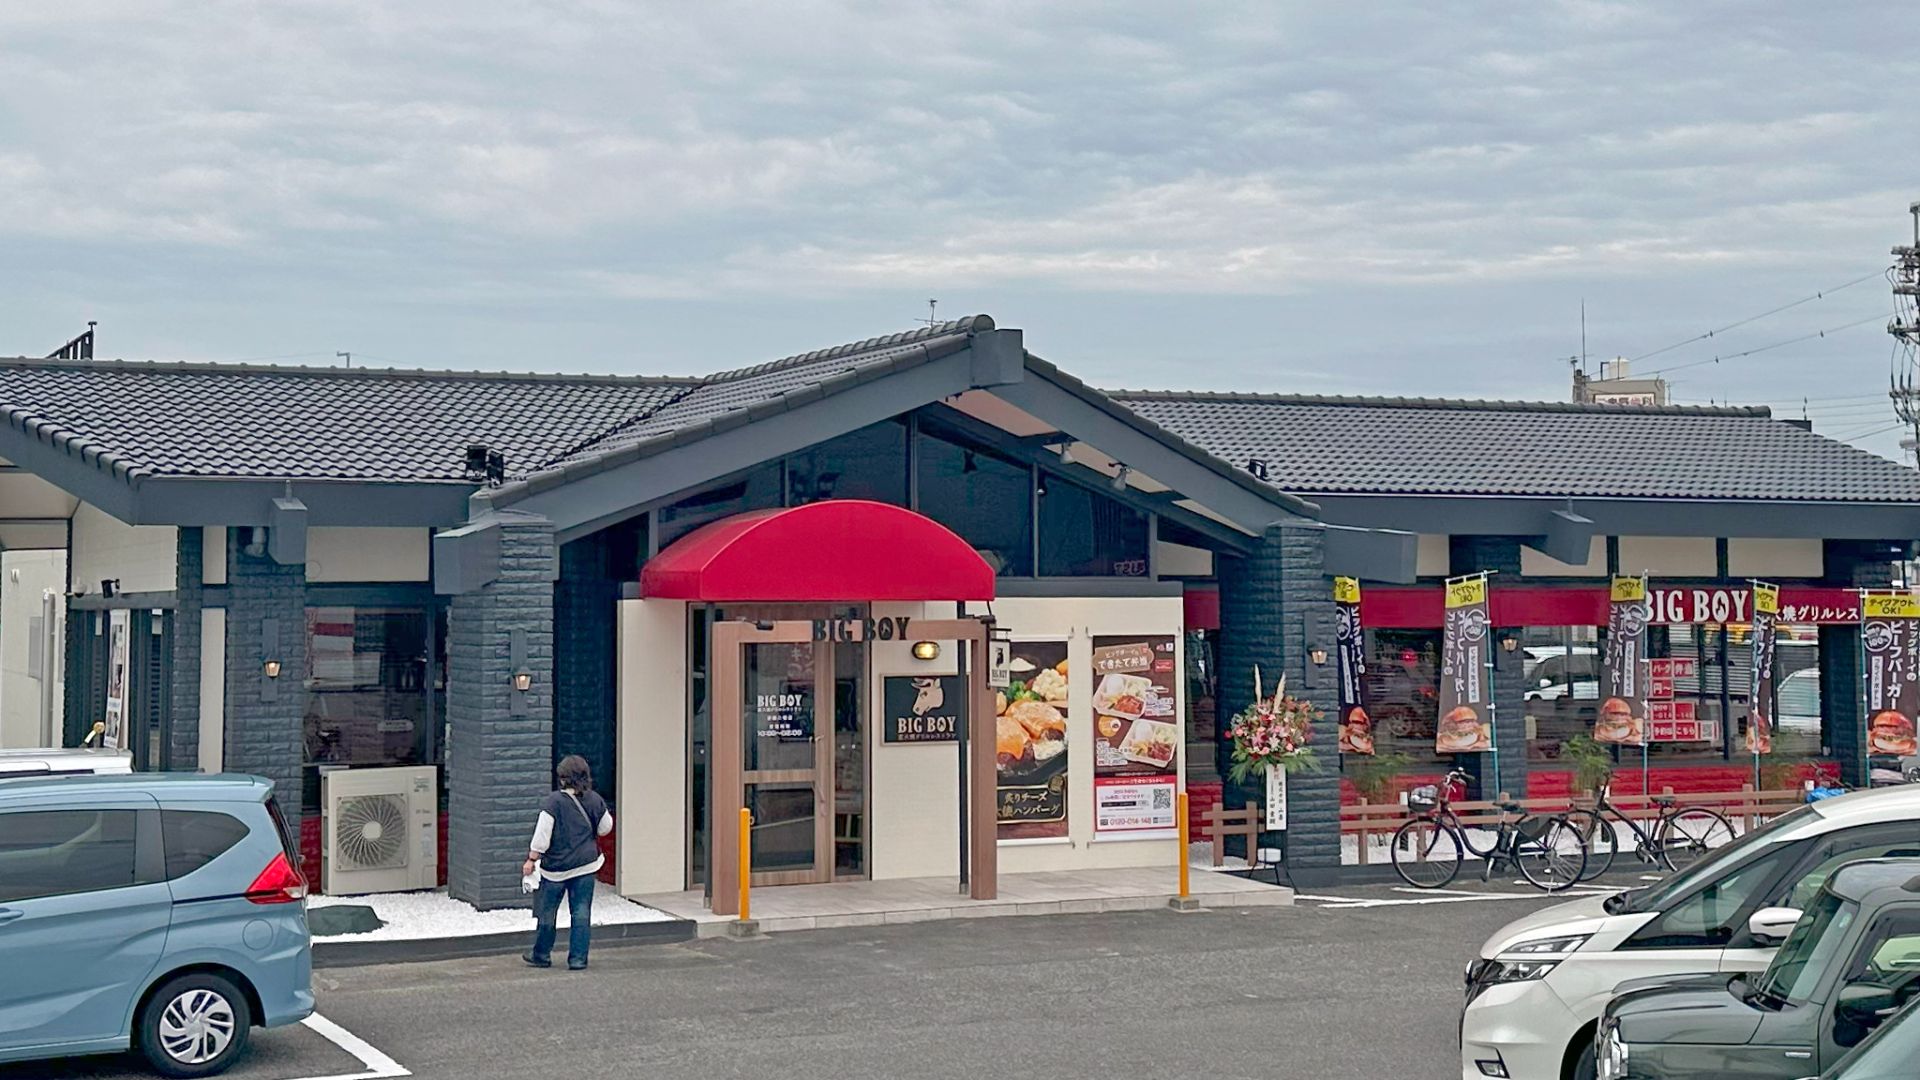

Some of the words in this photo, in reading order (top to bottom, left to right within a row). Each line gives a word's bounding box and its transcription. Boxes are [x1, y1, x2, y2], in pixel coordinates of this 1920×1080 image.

[1644, 590, 1684, 622] BIG
[1693, 590, 1748, 622] BOY
[1869, 599, 1914, 608] テイクアウト
[1882, 607, 1901, 615] OK!
[812, 618, 854, 642] BIG
[862, 617, 910, 641] BOY
[1907, 621, 1919, 681] ビッグボーイの
[1098, 656, 1148, 670] できたて弁当
[1887, 620, 1904, 710] ビーフバーガー
[758, 695, 776, 706] BIG
[780, 694, 802, 706] BOY
[898, 717, 922, 733] BIG
[927, 716, 956, 732] BOY
